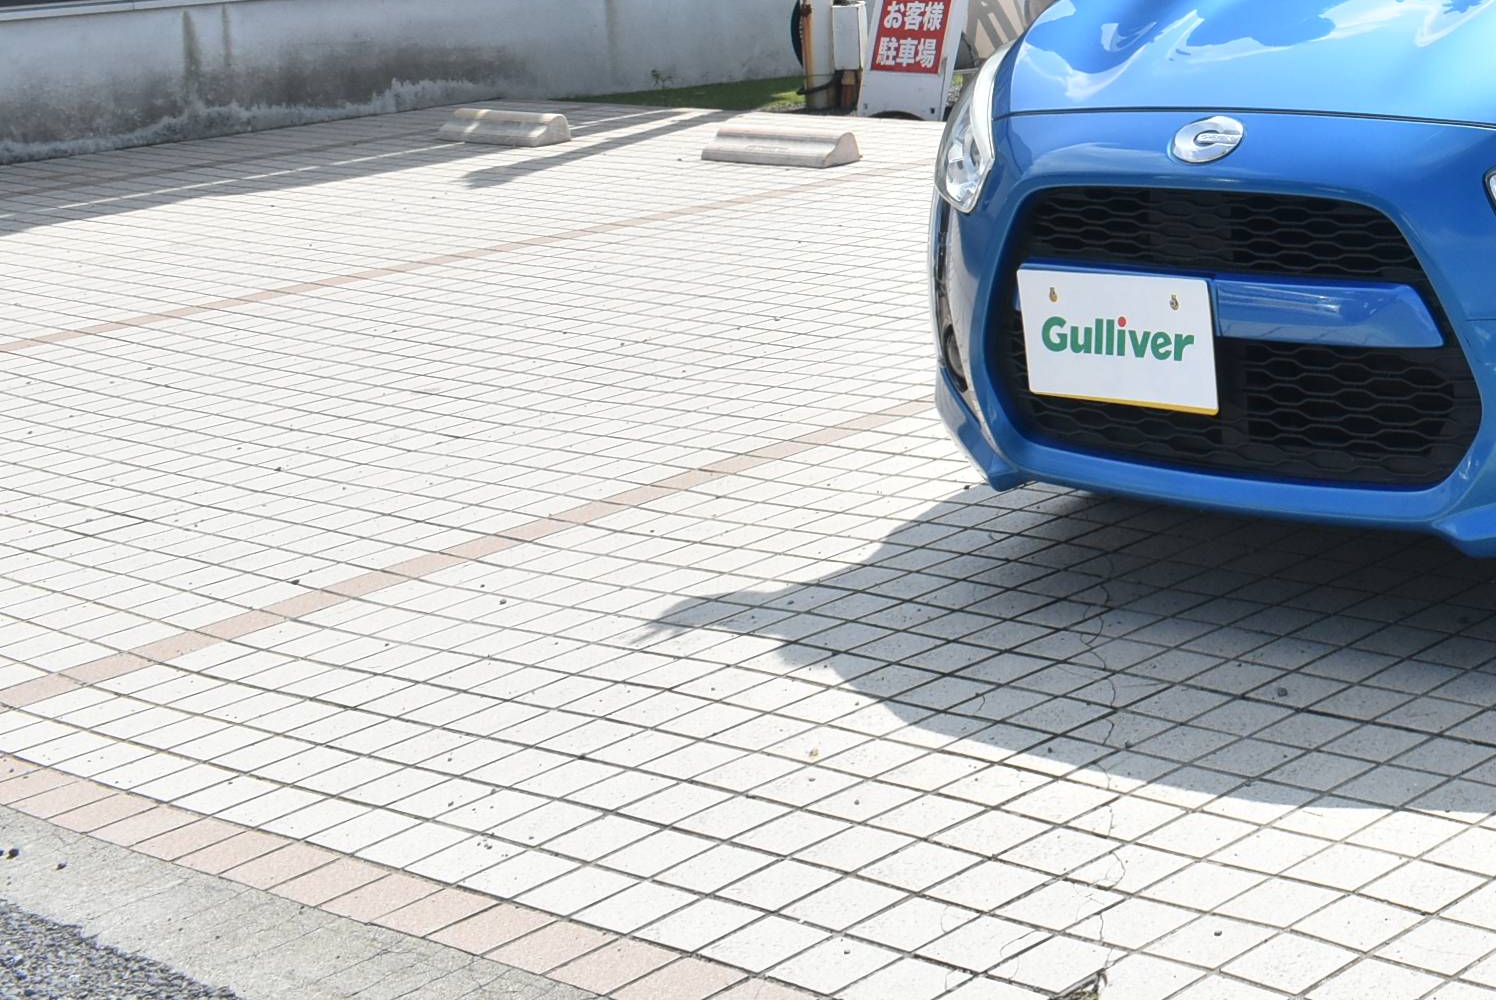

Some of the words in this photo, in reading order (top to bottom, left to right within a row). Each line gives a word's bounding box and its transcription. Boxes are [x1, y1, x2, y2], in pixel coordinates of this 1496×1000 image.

[884, 1, 944, 31] お客様
[876, 37, 937, 68] 駐車場
[1041, 316, 1195, 361] Gulliver
